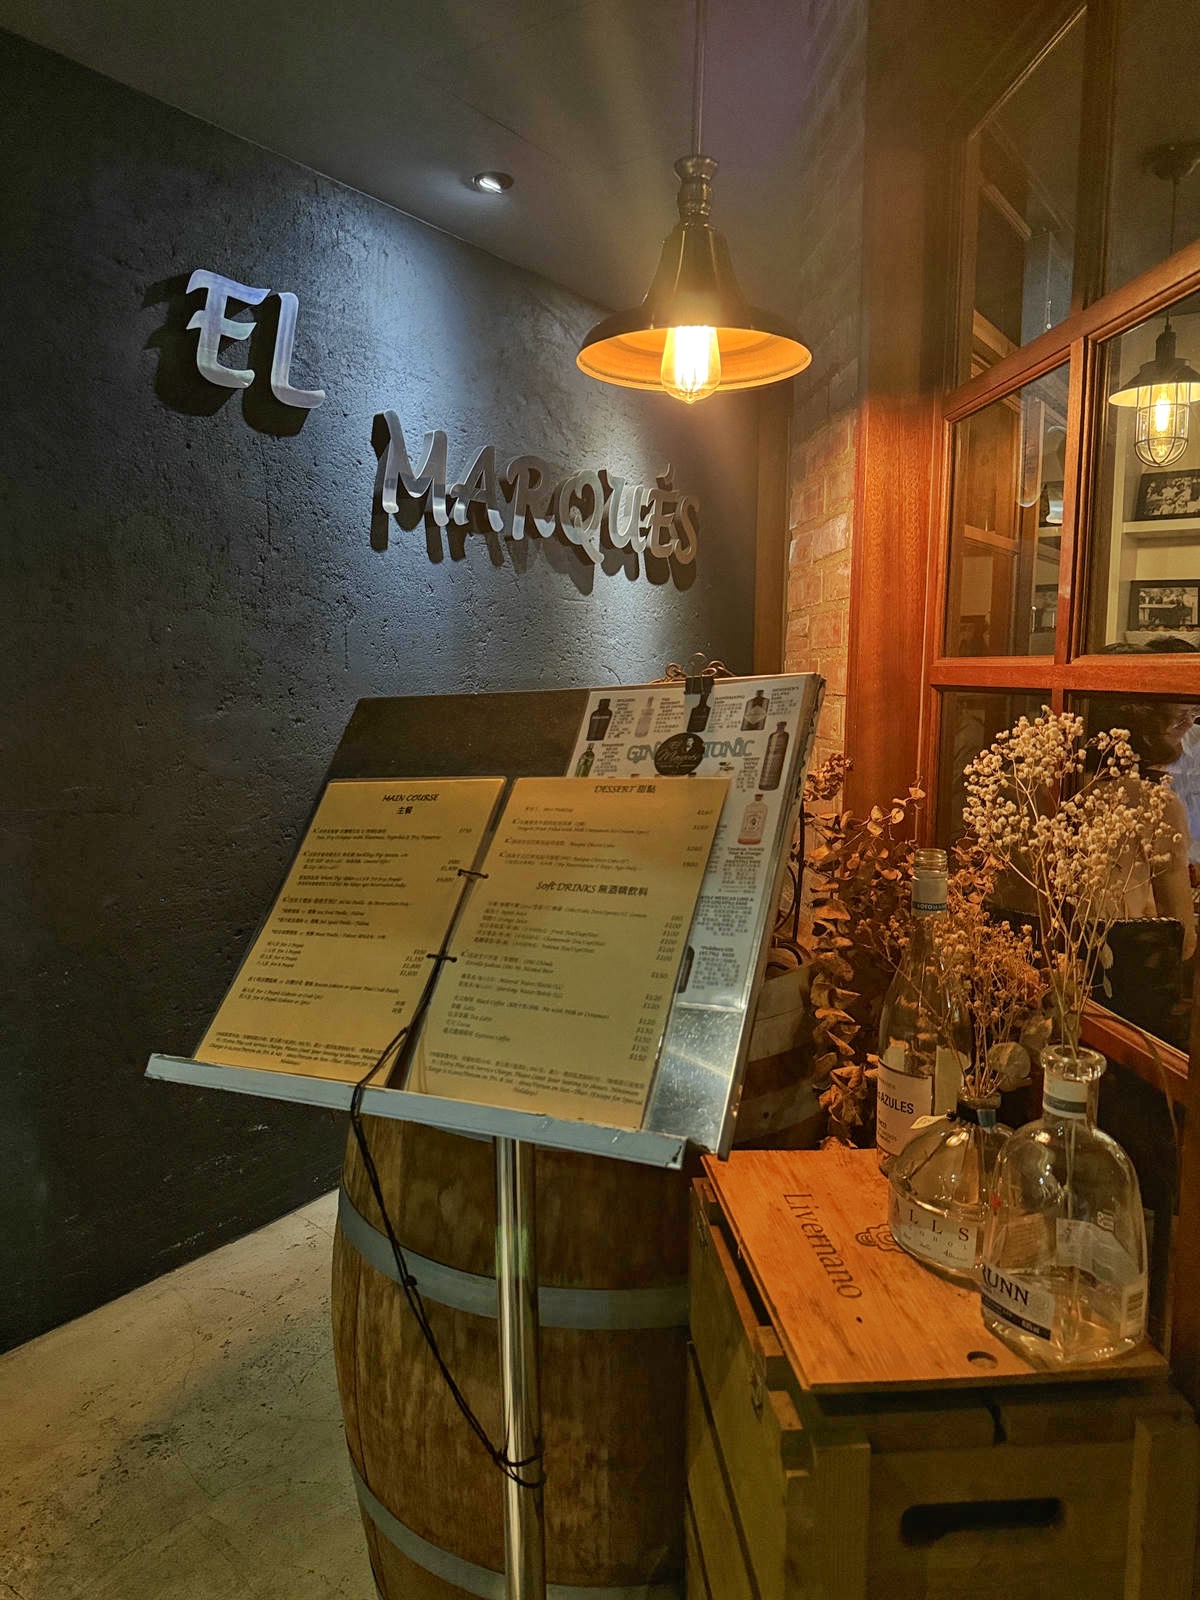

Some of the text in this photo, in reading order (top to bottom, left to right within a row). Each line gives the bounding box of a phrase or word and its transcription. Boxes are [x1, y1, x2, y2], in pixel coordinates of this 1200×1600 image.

[594, 784, 637, 793] DESSERT
[382, 793, 440, 801] MAIN COURSE
[536, 881, 557, 891] Soft
[557, 882, 597, 893] DRINKS
[783, 1193, 863, 1299] Livernano
